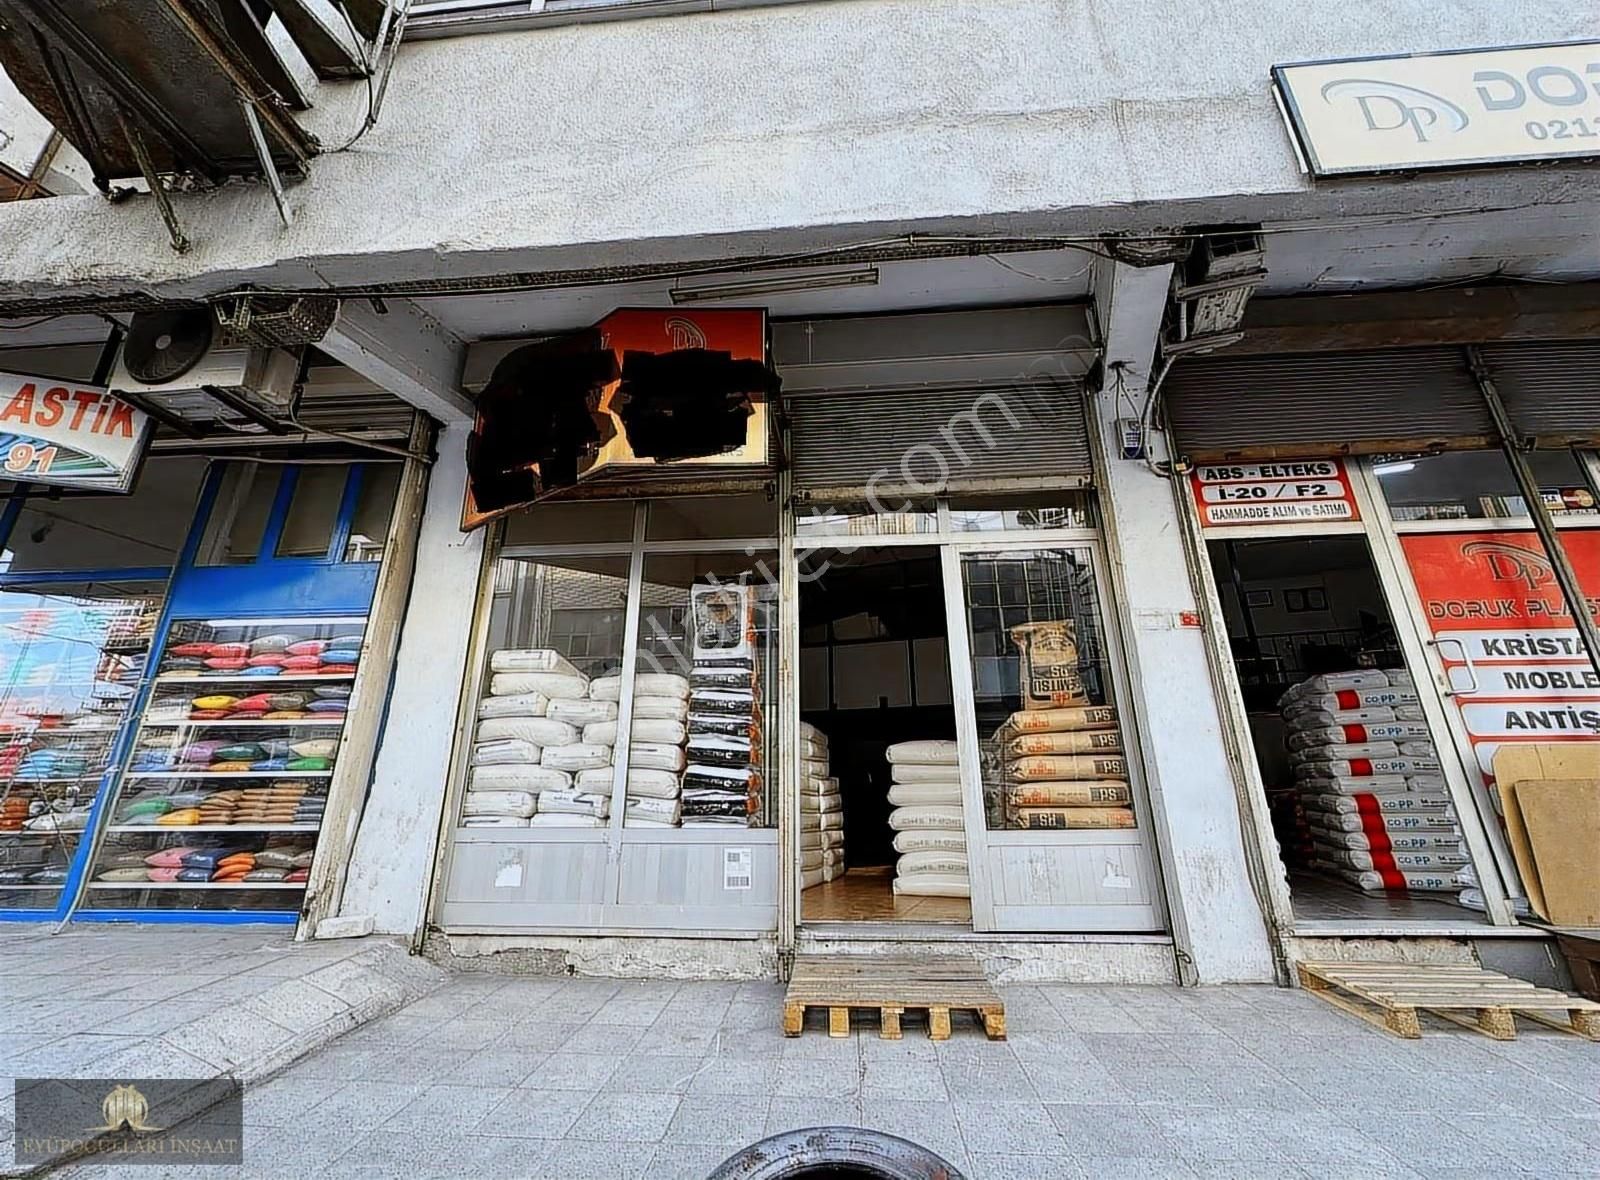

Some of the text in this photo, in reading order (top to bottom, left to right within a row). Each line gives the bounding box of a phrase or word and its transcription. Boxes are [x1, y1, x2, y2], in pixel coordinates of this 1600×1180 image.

[4, 443, 58, 475] 91
[1205, 467, 1244, 481] ABS
[1260, 463, 1332, 477] ELTEKS
[1296, 485, 1328, 496] F2
[1211, 507, 1270, 520] HAMMADDE
[1273, 505, 1297, 517] ALIM
[1313, 504, 1347, 515] SATIMI
[1429, 600, 1518, 619] DORUK
